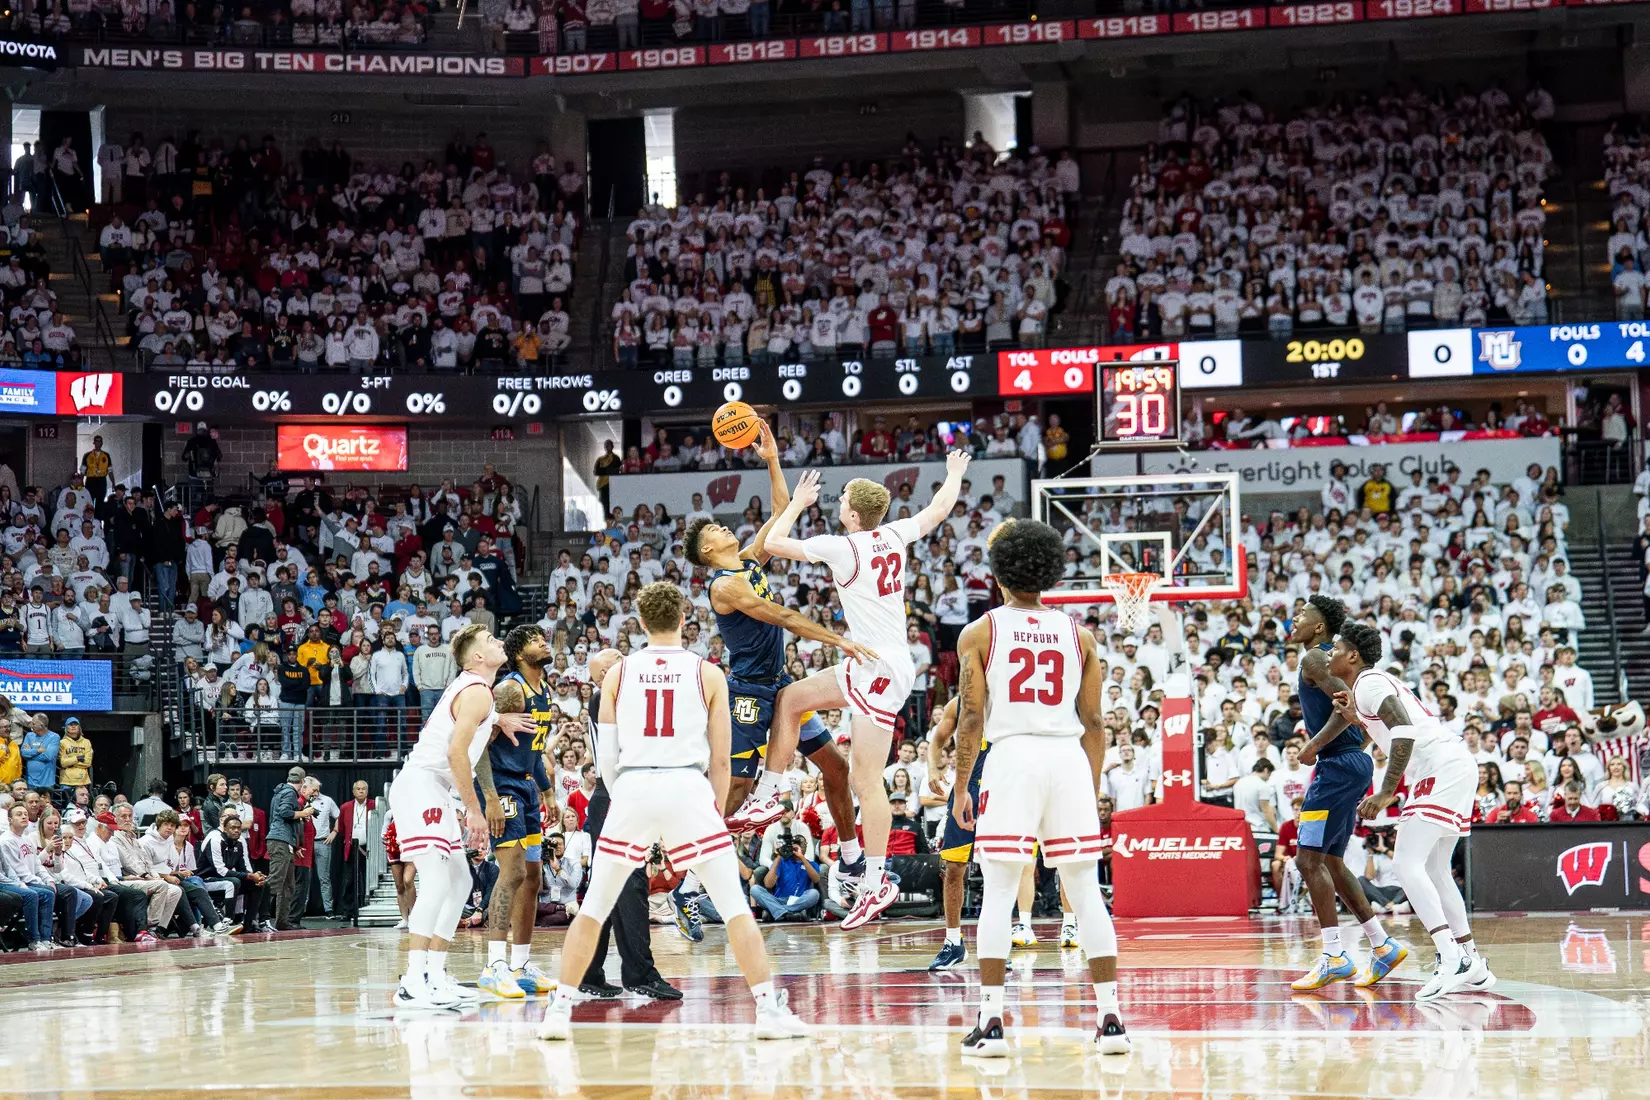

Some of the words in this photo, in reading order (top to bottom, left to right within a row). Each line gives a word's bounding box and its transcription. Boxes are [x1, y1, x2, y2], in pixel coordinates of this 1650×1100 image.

[1282, 3, 1354, 25] 1923
[1380, 0, 1452, 17] 1924
[1093, 16, 1158, 37] 1918
[1187, 10, 1253, 31] 1921
[905, 28, 969, 49] 1914
[998, 22, 1062, 43] 1916
[0, 41, 57, 60] TOYOTA
[723, 41, 785, 62] 1912
[814, 35, 877, 55] 1913
[83, 48, 183, 68] MEN'S
[194, 51, 245, 69] BIG
[255, 52, 314, 71] TEN
[324, 54, 506, 76] CHAMPIONS
[541, 54, 608, 73] 1907
[631, 48, 696, 68] 1908
[1550, 325, 1601, 342] FOULS
[1619, 323, 1650, 338] TOL
[1008, 352, 1039, 367] TOL
[1050, 349, 1099, 365] FOULS
[1286, 338, 1365, 363] 20:00
[1434, 344, 1452, 364] 0
[1567, 343, 1588, 366] 0
[1625, 340, 1645, 363] 4
[778, 364, 806, 378] REB
[842, 361, 863, 375] TO
[894, 358, 921, 373] STL
[946, 355, 973, 370] AST
[1200, 355, 1217, 375] 0
[1311, 362, 1341, 379] 1ST
[168, 376, 207, 388] FIELD
[211, 376, 250, 388] GOAL
[361, 376, 392, 389] 3-PT
[497, 377, 532, 390] FREE
[535, 375, 593, 389] THROWS
[653, 370, 692, 383] OREB
[713, 367, 750, 381] DREB
[899, 373, 918, 395] 0
[951, 370, 970, 393] 0
[1013, 370, 1033, 391] 4
[1064, 367, 1084, 389] 0
[1115, 368, 1172, 393] 19:59
[2, 388, 35, 397] FAMILY
[664, 385, 682, 407] 0
[724, 382, 742, 401] 0
[783, 378, 801, 400] 0
[842, 375, 861, 397] 0
[154, 389, 204, 415] 0/0
[252, 390, 292, 411] 0%
[322, 391, 371, 416] 0/0
[406, 393, 446, 414] 0%
[493, 391, 541, 417] 0/0
[582, 389, 621, 412] 0%
[1115, 394, 1166, 436] 30
[303, 433, 381, 461] Quartz
[870, 552, 903, 598] 22
[1013, 631, 1059, 644] HEPBURN
[28, 681, 72, 692] FAMILY
[639, 673, 682, 684] KLESMIT
[1009, 647, 1064, 706] 23
[643, 688, 675, 737] 11
[1128, 836, 1243, 852] MUELLER
[1147, 851, 1181, 860] SPORTS
[1181, 851, 1223, 860] MEDICINE
